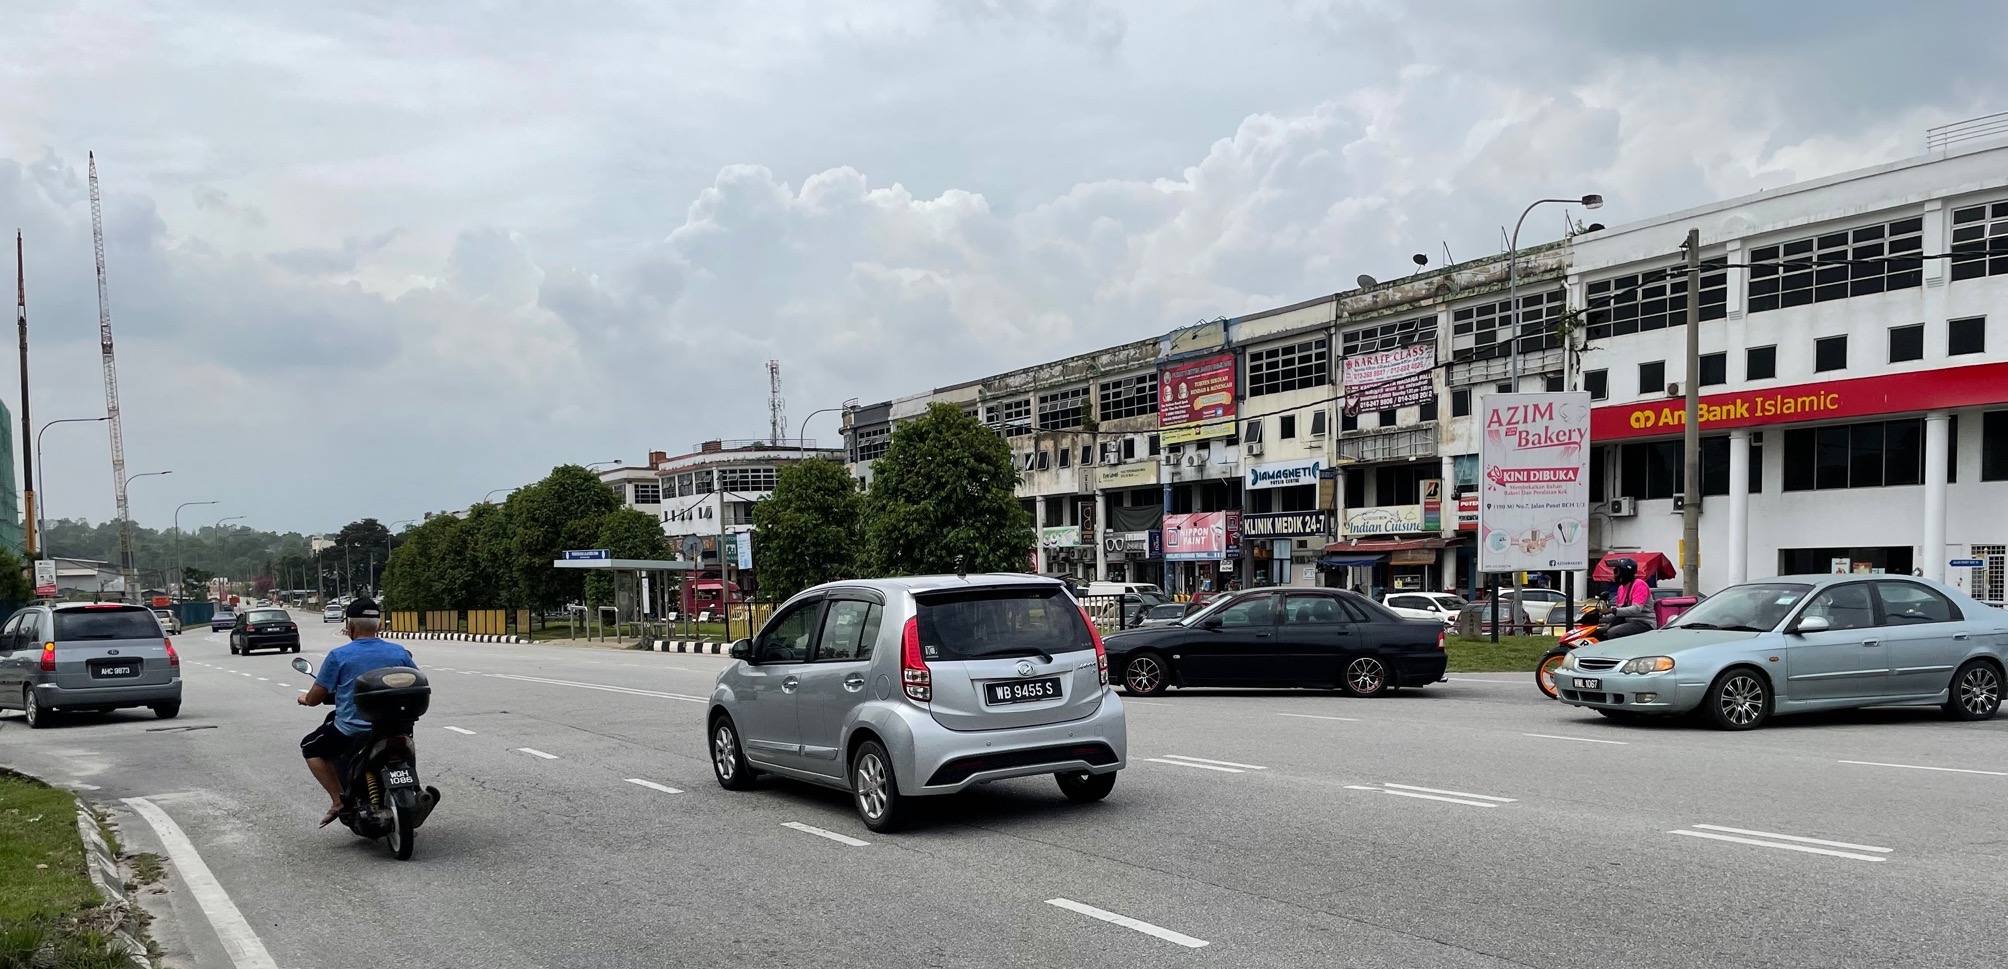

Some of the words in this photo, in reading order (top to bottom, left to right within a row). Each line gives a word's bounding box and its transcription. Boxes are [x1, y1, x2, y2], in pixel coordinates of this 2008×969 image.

[1354, 353, 1390, 368] KARATE
[1393, 345, 1425, 361] CLASS
[1755, 391, 1839, 417] Islamic
[1487, 402, 1554, 428] AZIM
[1517, 425, 1588, 451] Bakery
[1503, 471, 1528, 482] KINI
[1530, 470, 1576, 481] DIBUKA
[1180, 527, 1209, 536] NIPPON
[1244, 518, 1273, 535] KLINIK
[1275, 516, 1303, 534] MEDIK
[1305, 514, 1325, 532] 24-7
[1350, 522, 1382, 534] Indian
[1384, 520, 1420, 532] Cuisine
[1184, 536, 1206, 546] PAINT
[996, 687, 1011, 699] WB
[1014, 684, 1043, 698] 9455
[1046, 682, 1053, 694] S
[1585, 679, 1598, 688] 1067
[390, 770, 409, 778] WQH
[390, 776, 413, 784] 1086
